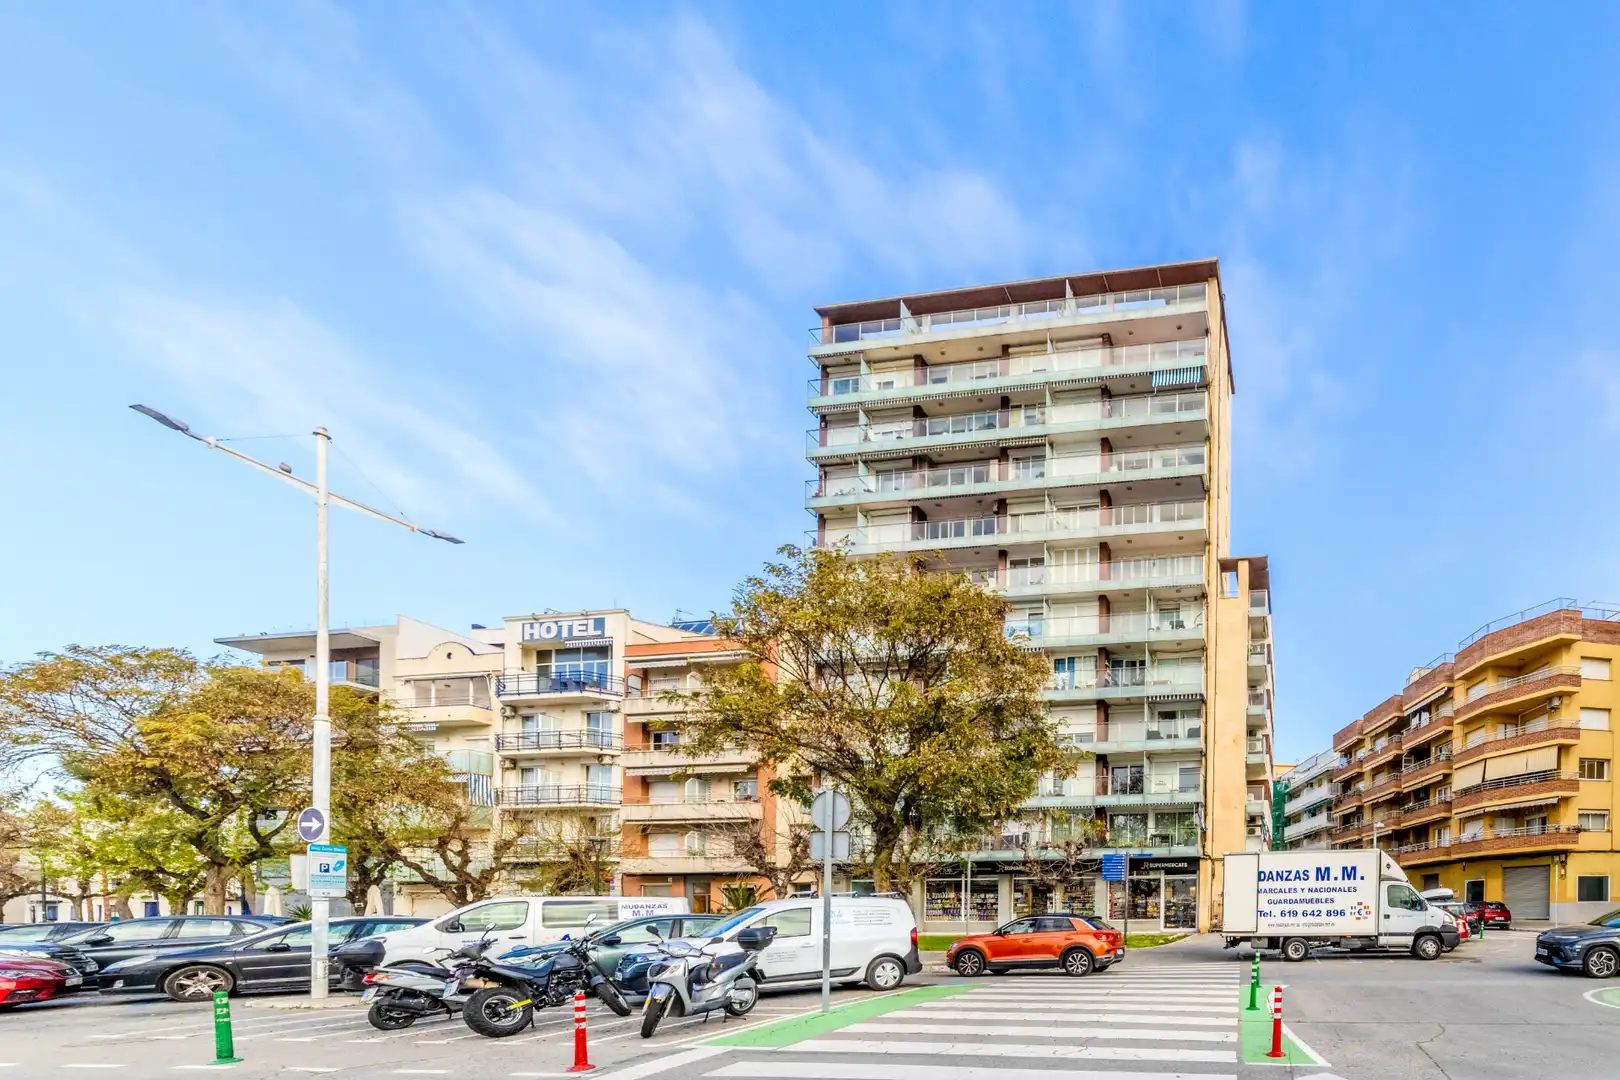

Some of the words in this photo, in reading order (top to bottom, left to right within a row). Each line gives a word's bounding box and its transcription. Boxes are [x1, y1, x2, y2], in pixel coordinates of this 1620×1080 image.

[523, 618, 602, 641] HOTEL
[321, 863, 329, 872] P
[1258, 869, 1310, 882] DANZAS
[1315, 865, 1365, 882] M.M.
[1267, 897, 1335, 905] GUARDAMUEBLES
[1257, 910, 1276, 918] Tel.
[1280, 909, 1298, 918] 619
[1302, 909, 1322, 917] 642
[1326, 908, 1346, 917] 896
